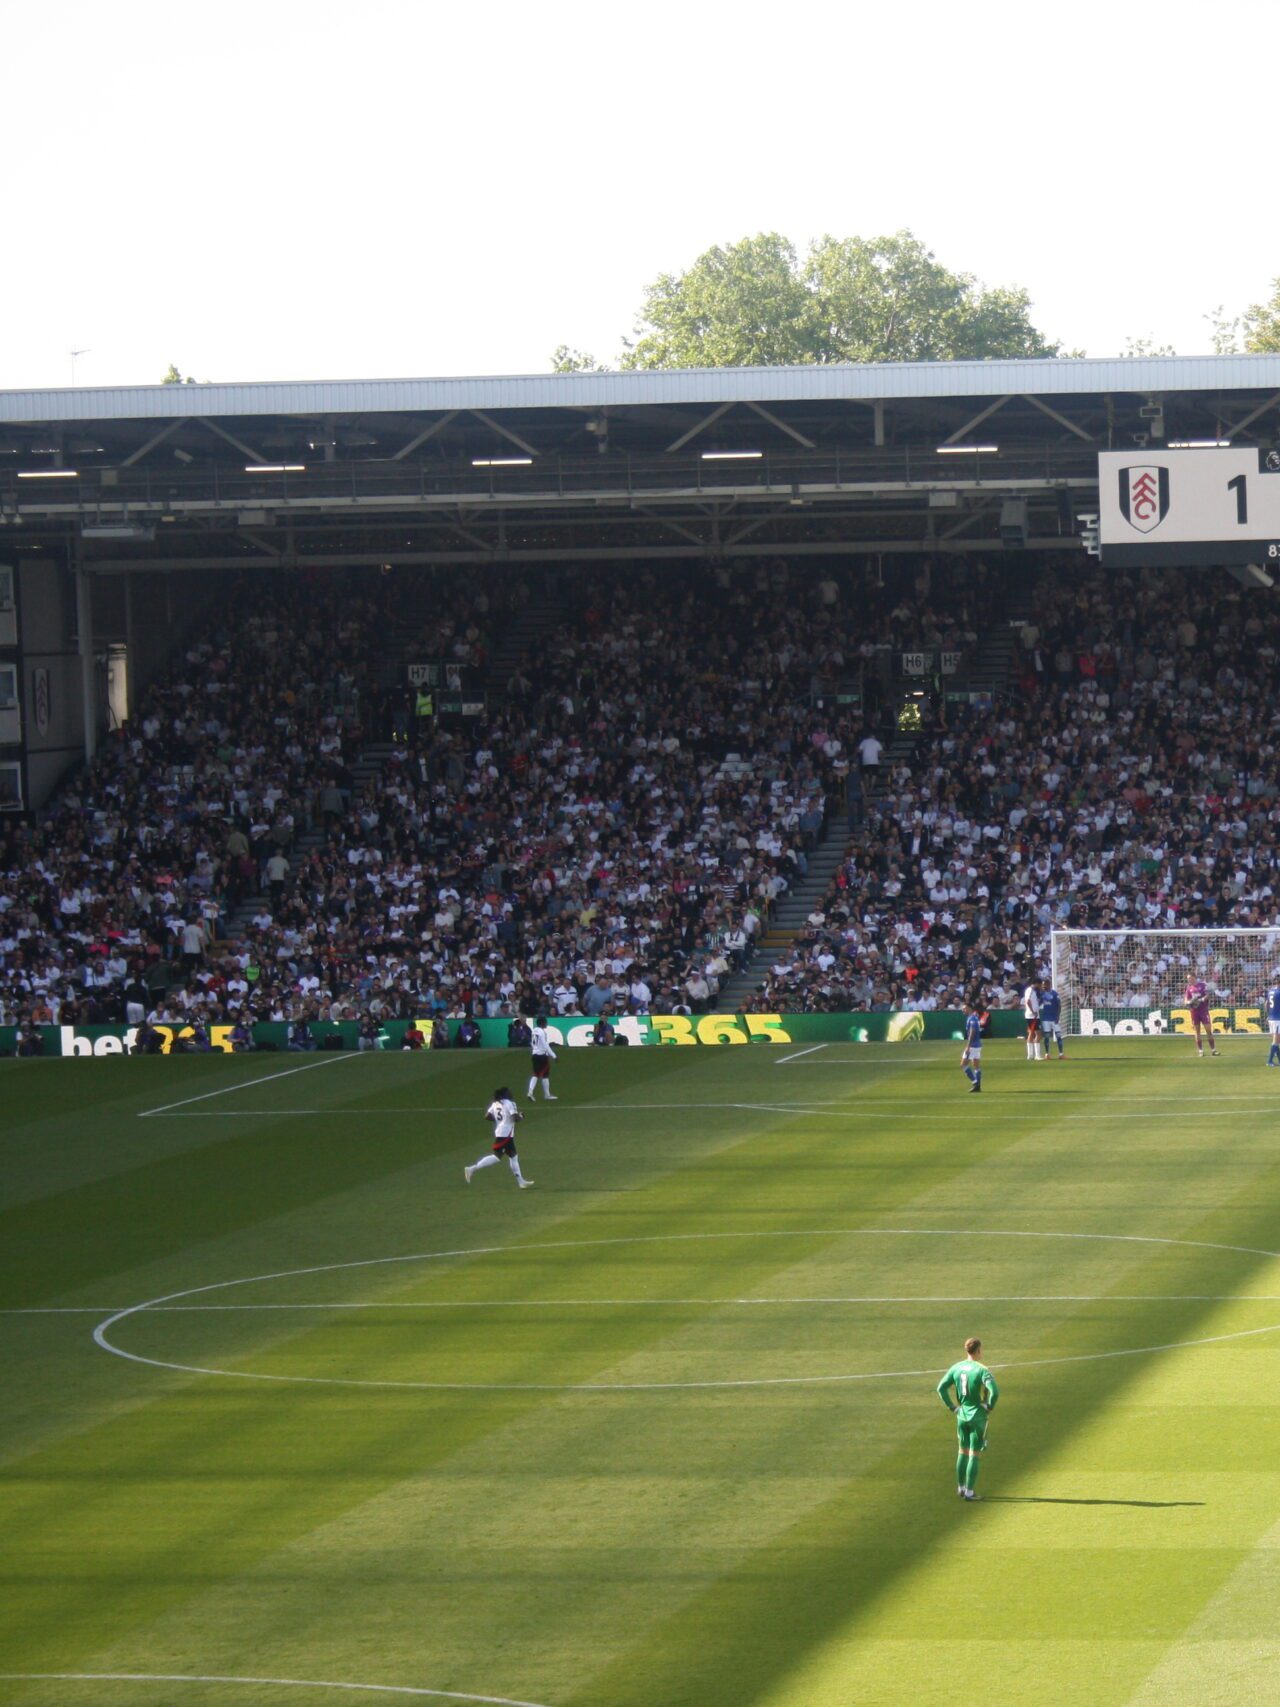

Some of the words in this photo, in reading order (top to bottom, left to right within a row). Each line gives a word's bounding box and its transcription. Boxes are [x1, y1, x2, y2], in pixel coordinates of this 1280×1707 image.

[1132, 473, 1157, 520] FFC
[1227, 474, 1248, 525] 1
[905, 655, 922, 668] H6
[411, 667, 426, 679] H7
[1269, 995, 1275, 1009] 5
[960, 1373, 967, 1396] 1
